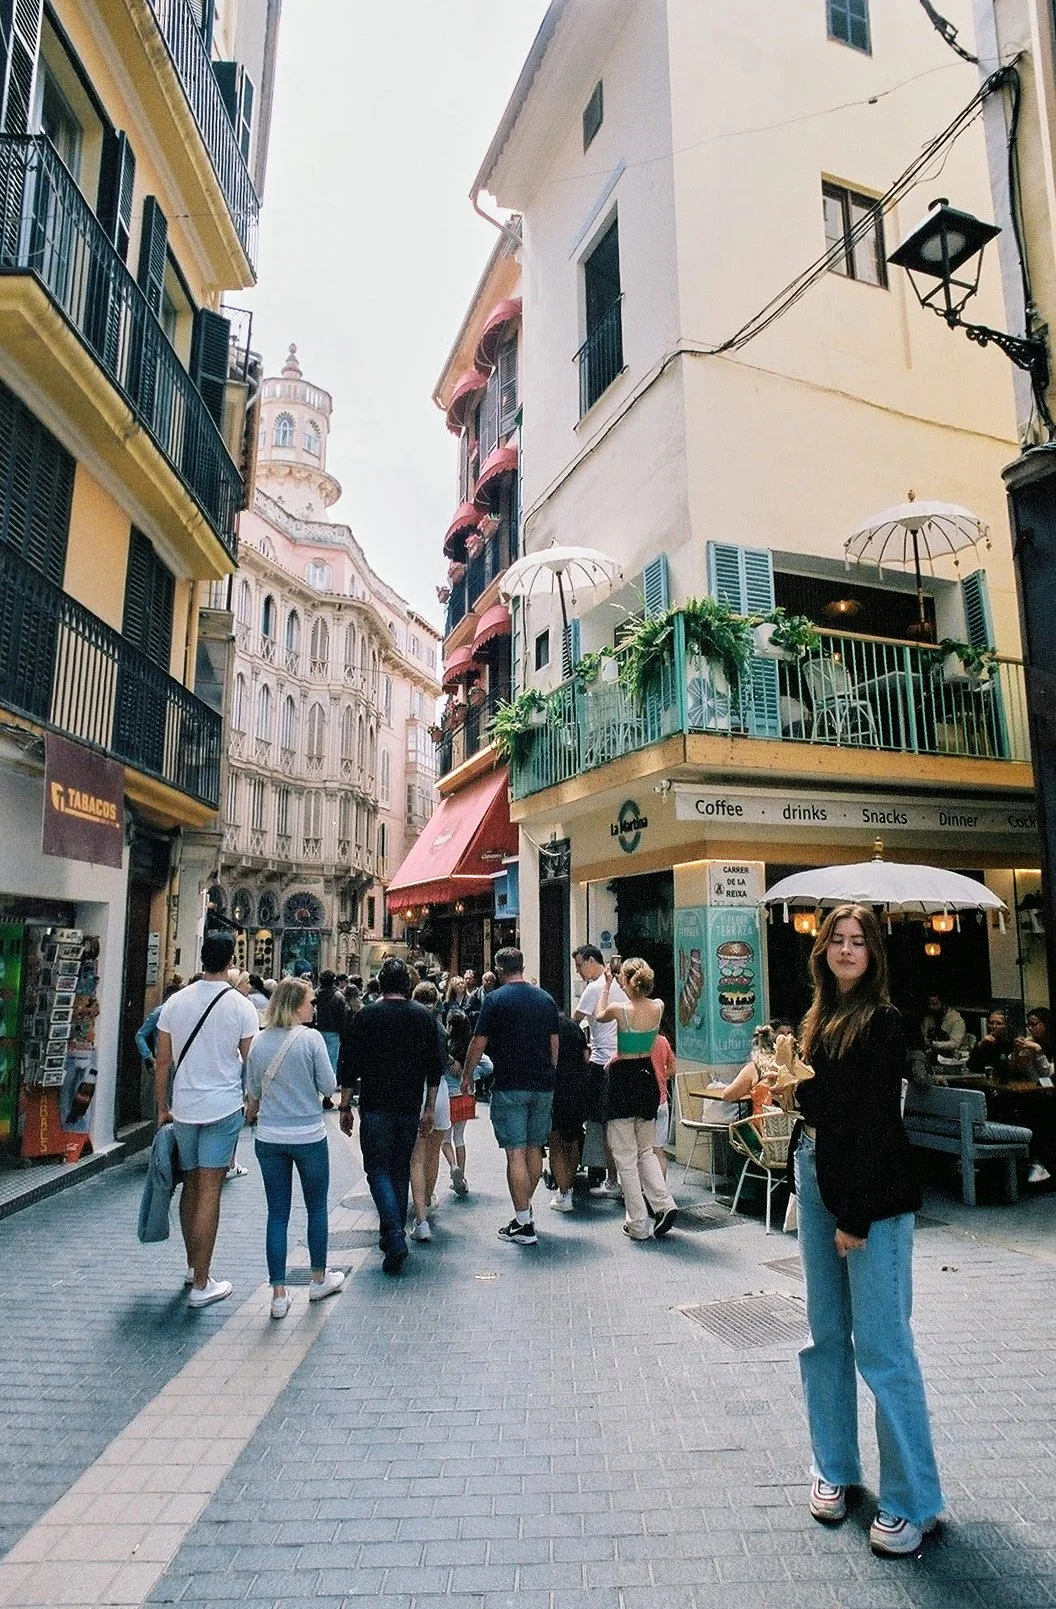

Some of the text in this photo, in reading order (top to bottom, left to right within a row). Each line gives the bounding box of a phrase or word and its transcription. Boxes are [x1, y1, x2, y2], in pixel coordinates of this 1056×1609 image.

[67, 788, 117, 821] TABACOS
[695, 799, 744, 817] Coffee
[782, 804, 828, 821] drinks
[862, 808, 908, 825] Snacks
[939, 811, 979, 828] Dinner
[610, 816, 648, 836] La Martina
[722, 866, 749, 874] CARRER
[726, 878, 747, 886] DE LA
[726, 890, 748, 898] REIXA
[716, 925, 754, 937] TERRAZA
